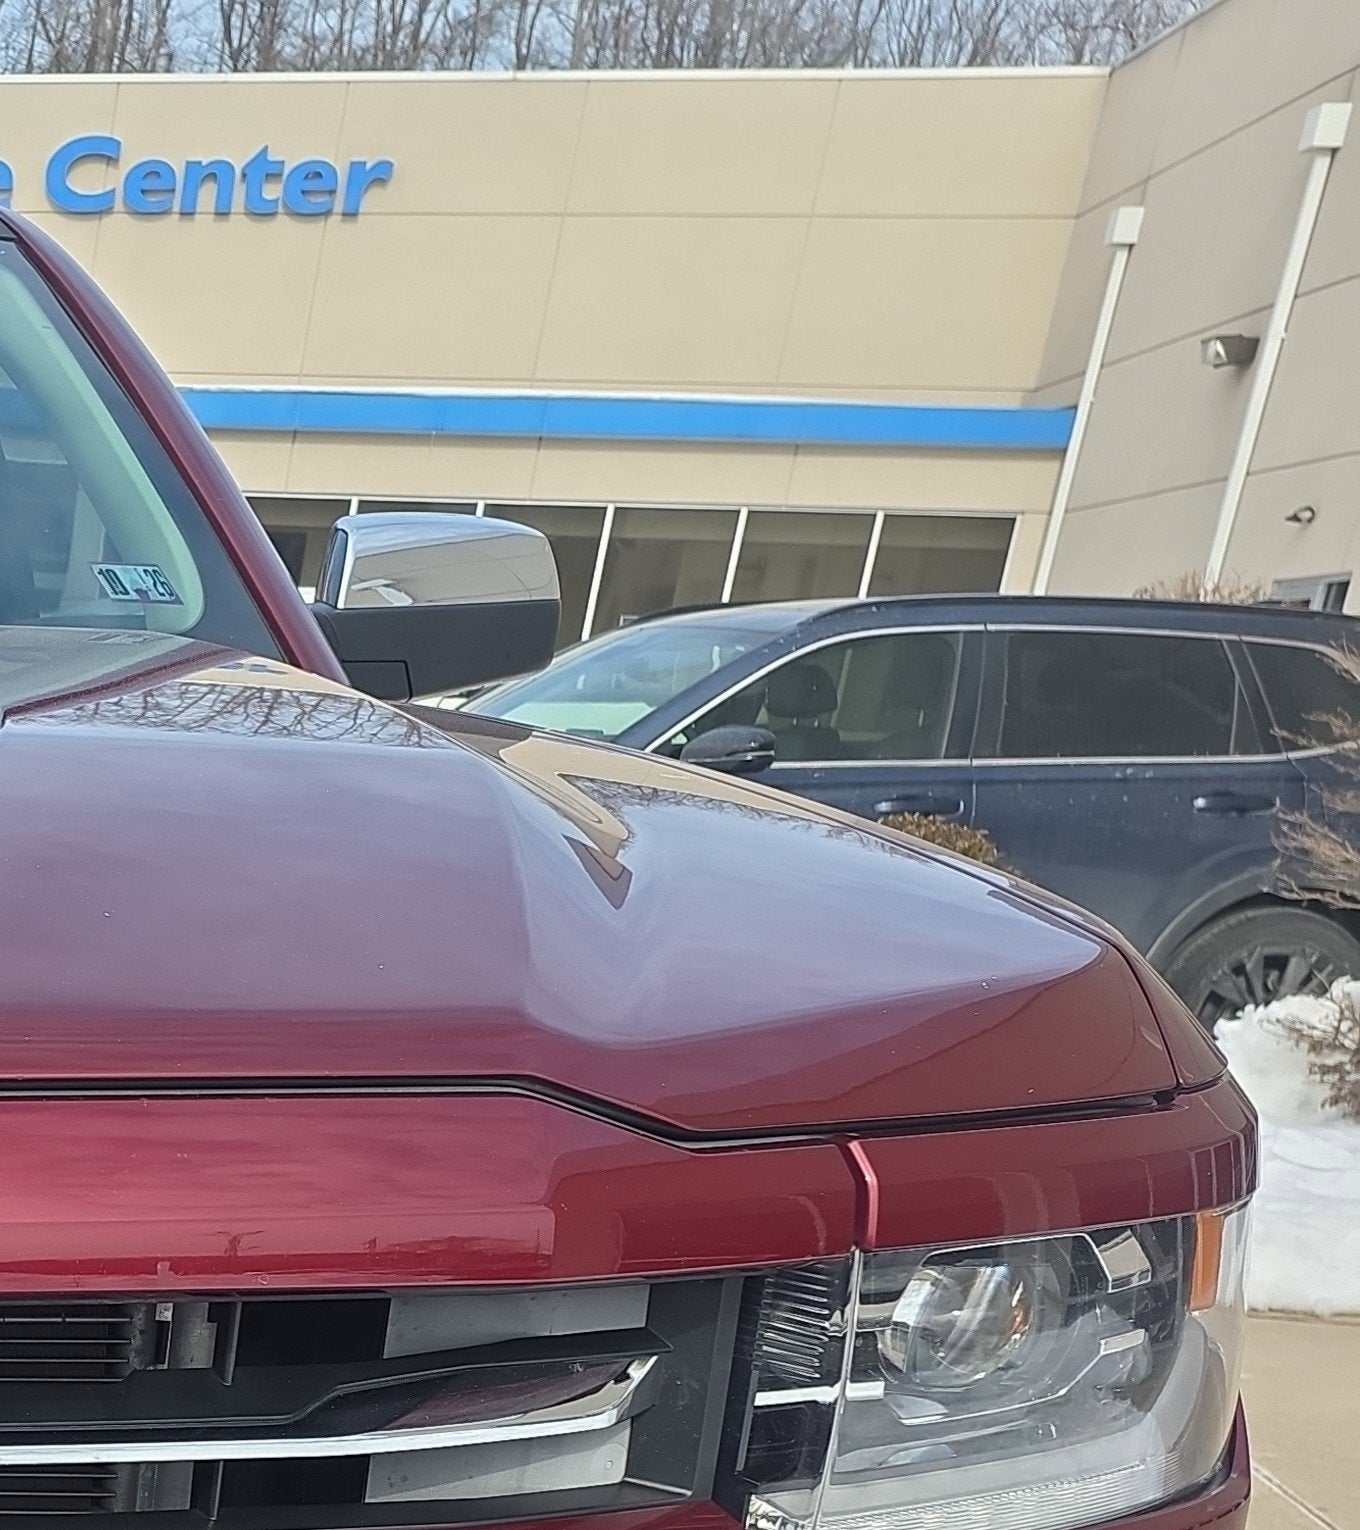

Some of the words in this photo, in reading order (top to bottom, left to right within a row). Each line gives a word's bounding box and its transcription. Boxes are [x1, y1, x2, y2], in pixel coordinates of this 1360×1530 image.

[45, 134, 395, 215] Center
[97, 568, 131, 596] 10
[142, 568, 175, 597] 26
